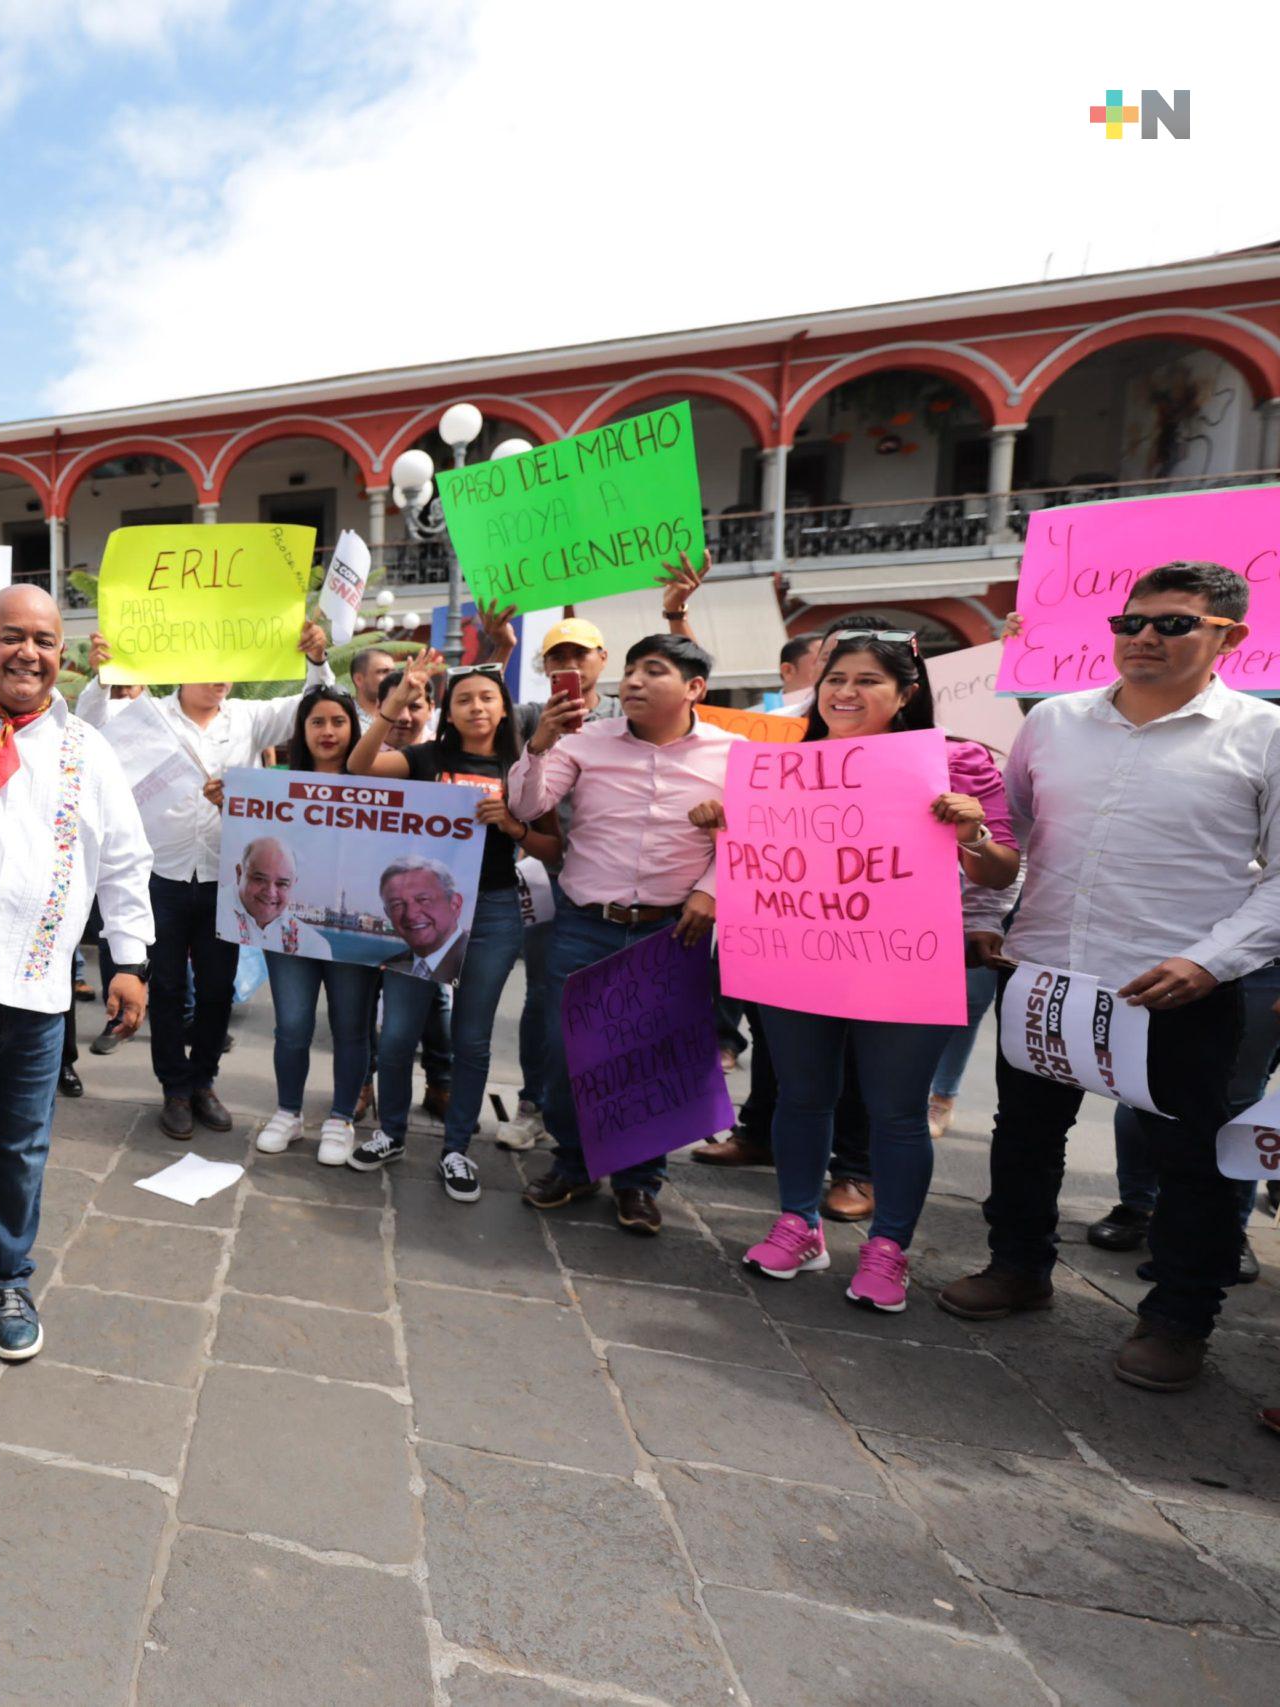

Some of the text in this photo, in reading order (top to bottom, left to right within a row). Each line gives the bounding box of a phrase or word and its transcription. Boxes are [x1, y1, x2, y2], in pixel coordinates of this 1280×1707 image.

[449, 410, 681, 508] PASO DEL MACHO
[486, 480, 627, 549] APOYA A
[148, 548, 244, 591] ERIC
[471, 516, 692, 599] ERIC CISNEROS
[120, 598, 167, 626] PARA
[116, 616, 284, 656] GOBERNADOR
[1014, 622, 1108, 687] Eric
[749, 746, 865, 791] ERIC
[303, 783, 390, 806] YO CON
[228, 796, 475, 841] ERIC CISNEROS
[747, 803, 865, 844] AMIGO
[726, 840, 914, 885] PASO DEL
[754, 888, 871, 922] MACHO
[722, 925, 939, 964] ESTA CONTIGO
[568, 980, 644, 1037] AMOR
[1051, 980, 1070, 1001] YO
[1097, 992, 1111, 1013] YO
[1024, 971, 1057, 1081] CISNERO
[1047, 1001, 1064, 1033] CON
[1093, 1014, 1110, 1045] CON
